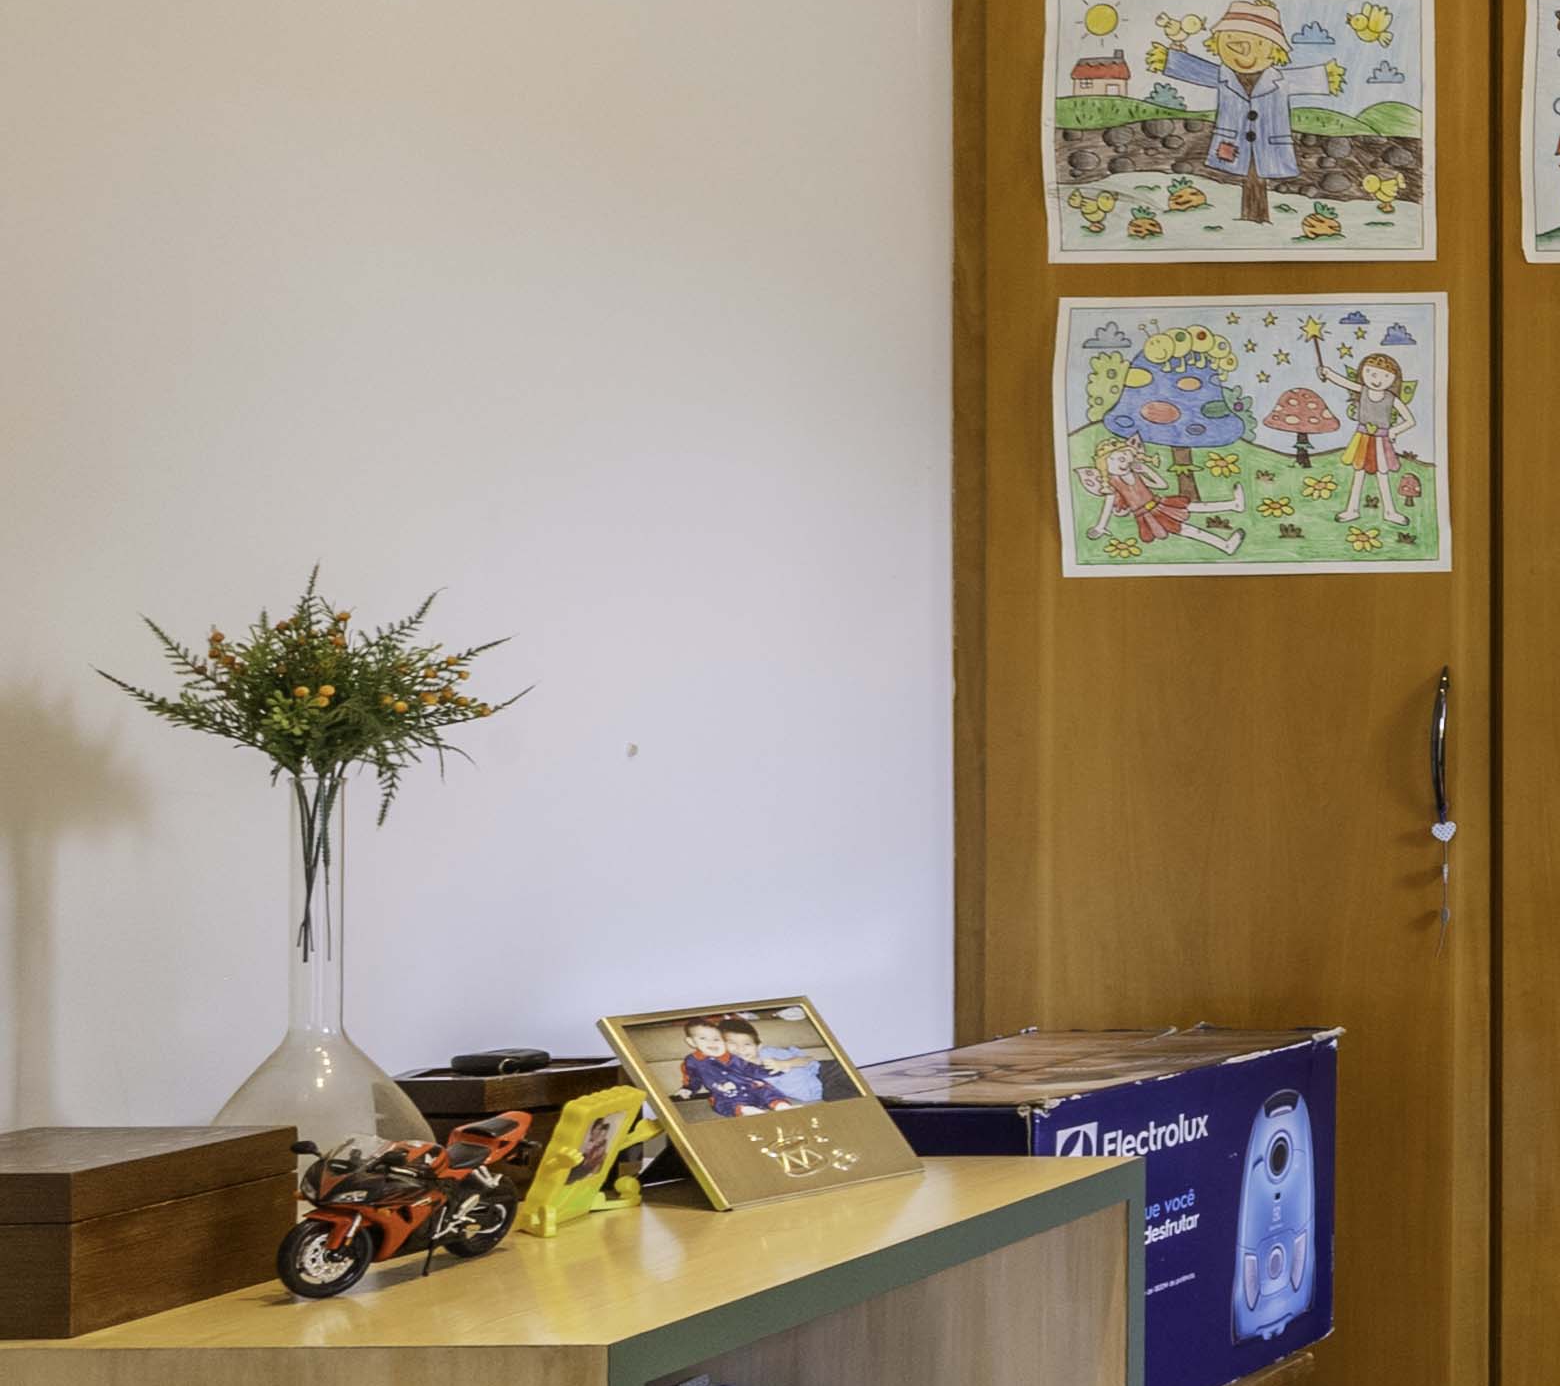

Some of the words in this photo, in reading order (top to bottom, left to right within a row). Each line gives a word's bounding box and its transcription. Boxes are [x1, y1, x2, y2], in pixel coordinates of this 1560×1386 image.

[1103, 1114, 1209, 1157] Electrolux
[1144, 1203, 1160, 1220] ue
[1164, 1188, 1196, 1212] você
